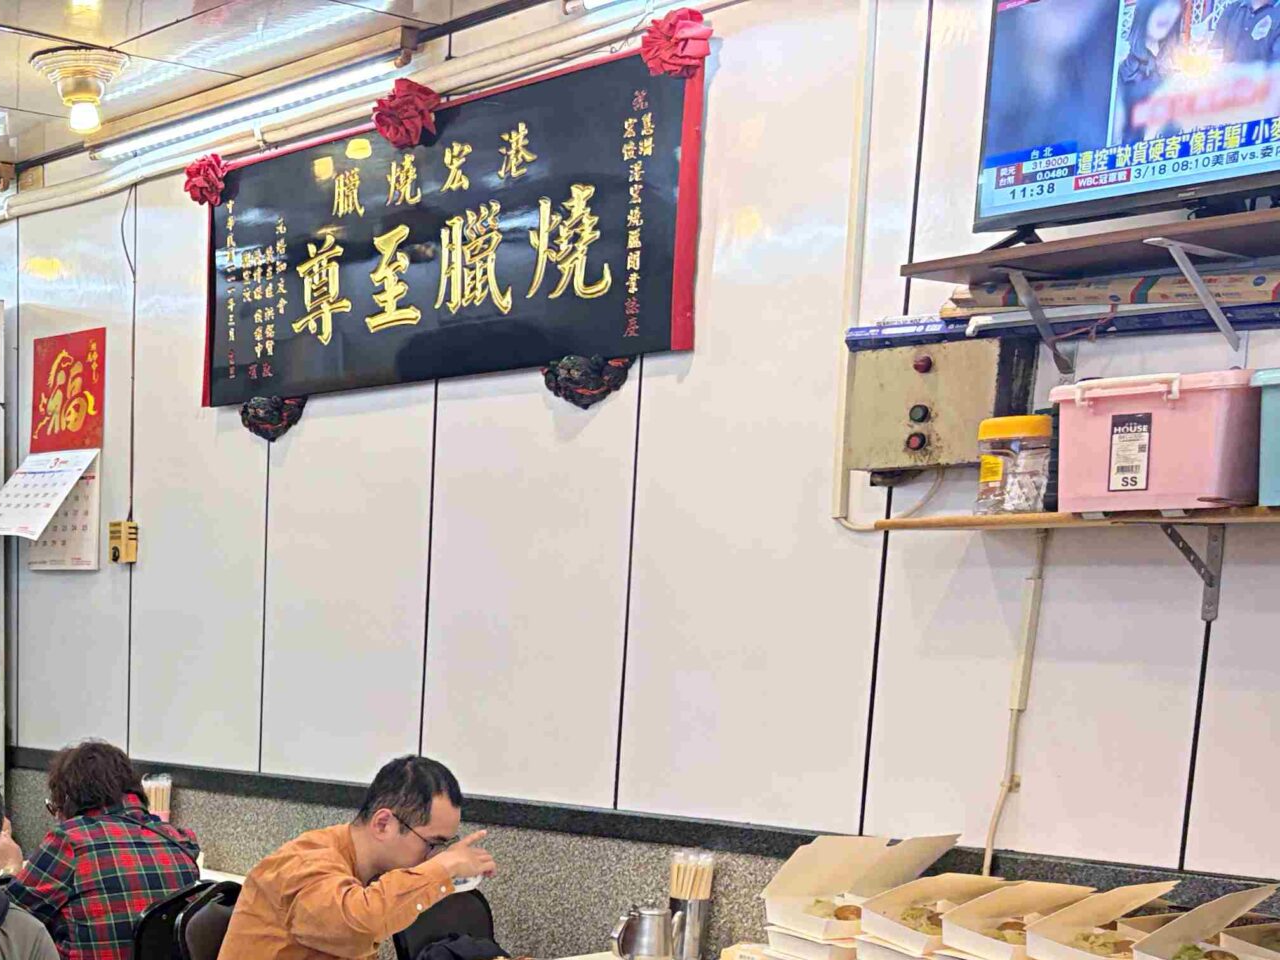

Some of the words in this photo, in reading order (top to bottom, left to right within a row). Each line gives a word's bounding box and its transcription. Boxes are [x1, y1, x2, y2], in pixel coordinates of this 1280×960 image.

[1030, 146, 1053, 160] 台北
[332, 122, 537, 218] 港宏燒臘
[1134, 163, 1167, 179] 3/18
[1009, 183, 1055, 200] 11:38
[292, 182, 612, 346] 燒臘至尊
[1113, 424, 1148, 434] HOUSE
[1121, 476, 1138, 487] SS
